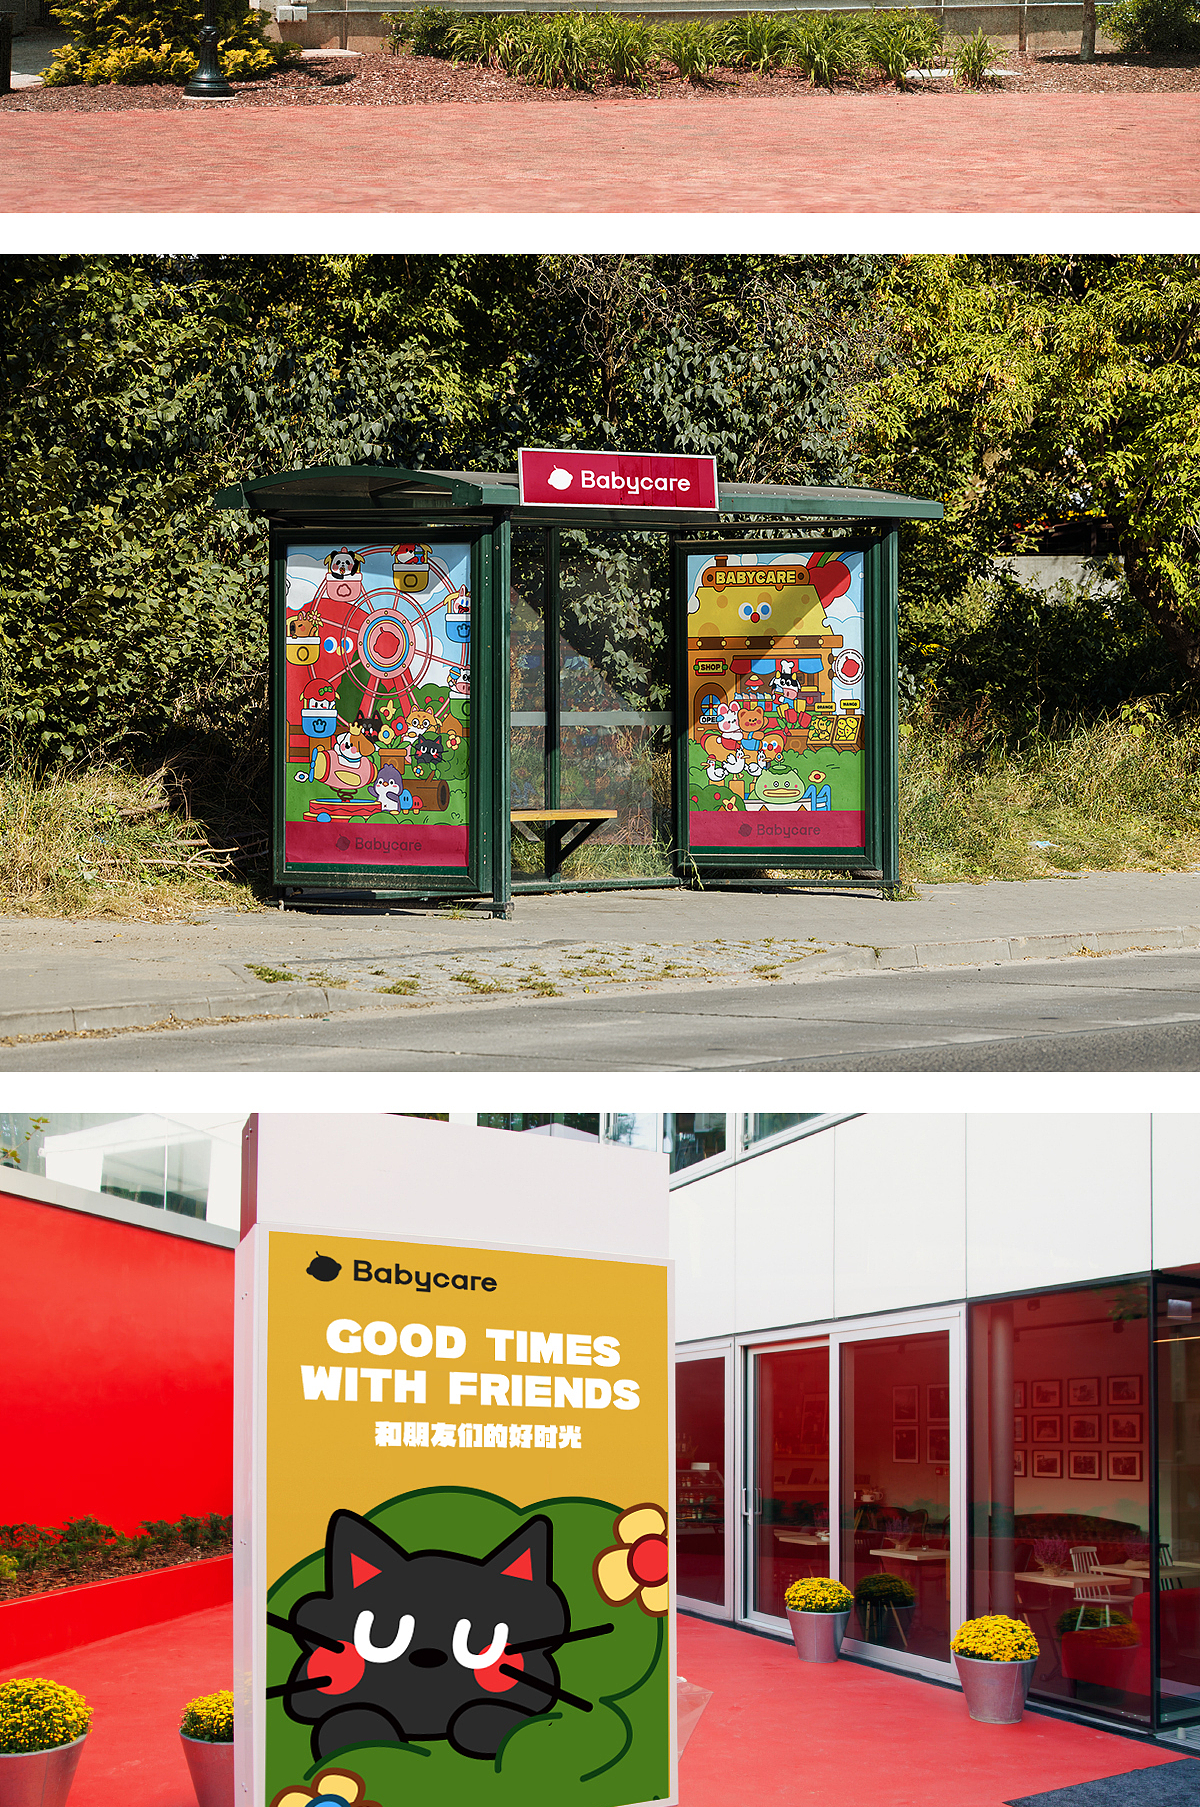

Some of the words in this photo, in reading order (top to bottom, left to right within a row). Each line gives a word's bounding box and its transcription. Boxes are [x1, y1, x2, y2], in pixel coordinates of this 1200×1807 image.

[581, 470, 691, 495] Babycare
[715, 570, 797, 585] BABYCARE
[700, 663, 721, 671] SHOP
[701, 716, 718, 724] OPE
[757, 824, 821, 838] Babycare
[355, 837, 423, 854] Babycare
[353, 1259, 498, 1292] Babycare
[326, 1318, 467, 1359] GOOD
[485, 1328, 622, 1367] TIMES
[300, 1364, 427, 1404] WITH
[449, 1371, 641, 1411] FRIENDS
[374, 1420, 583, 1450] 和朋友们的好时光
